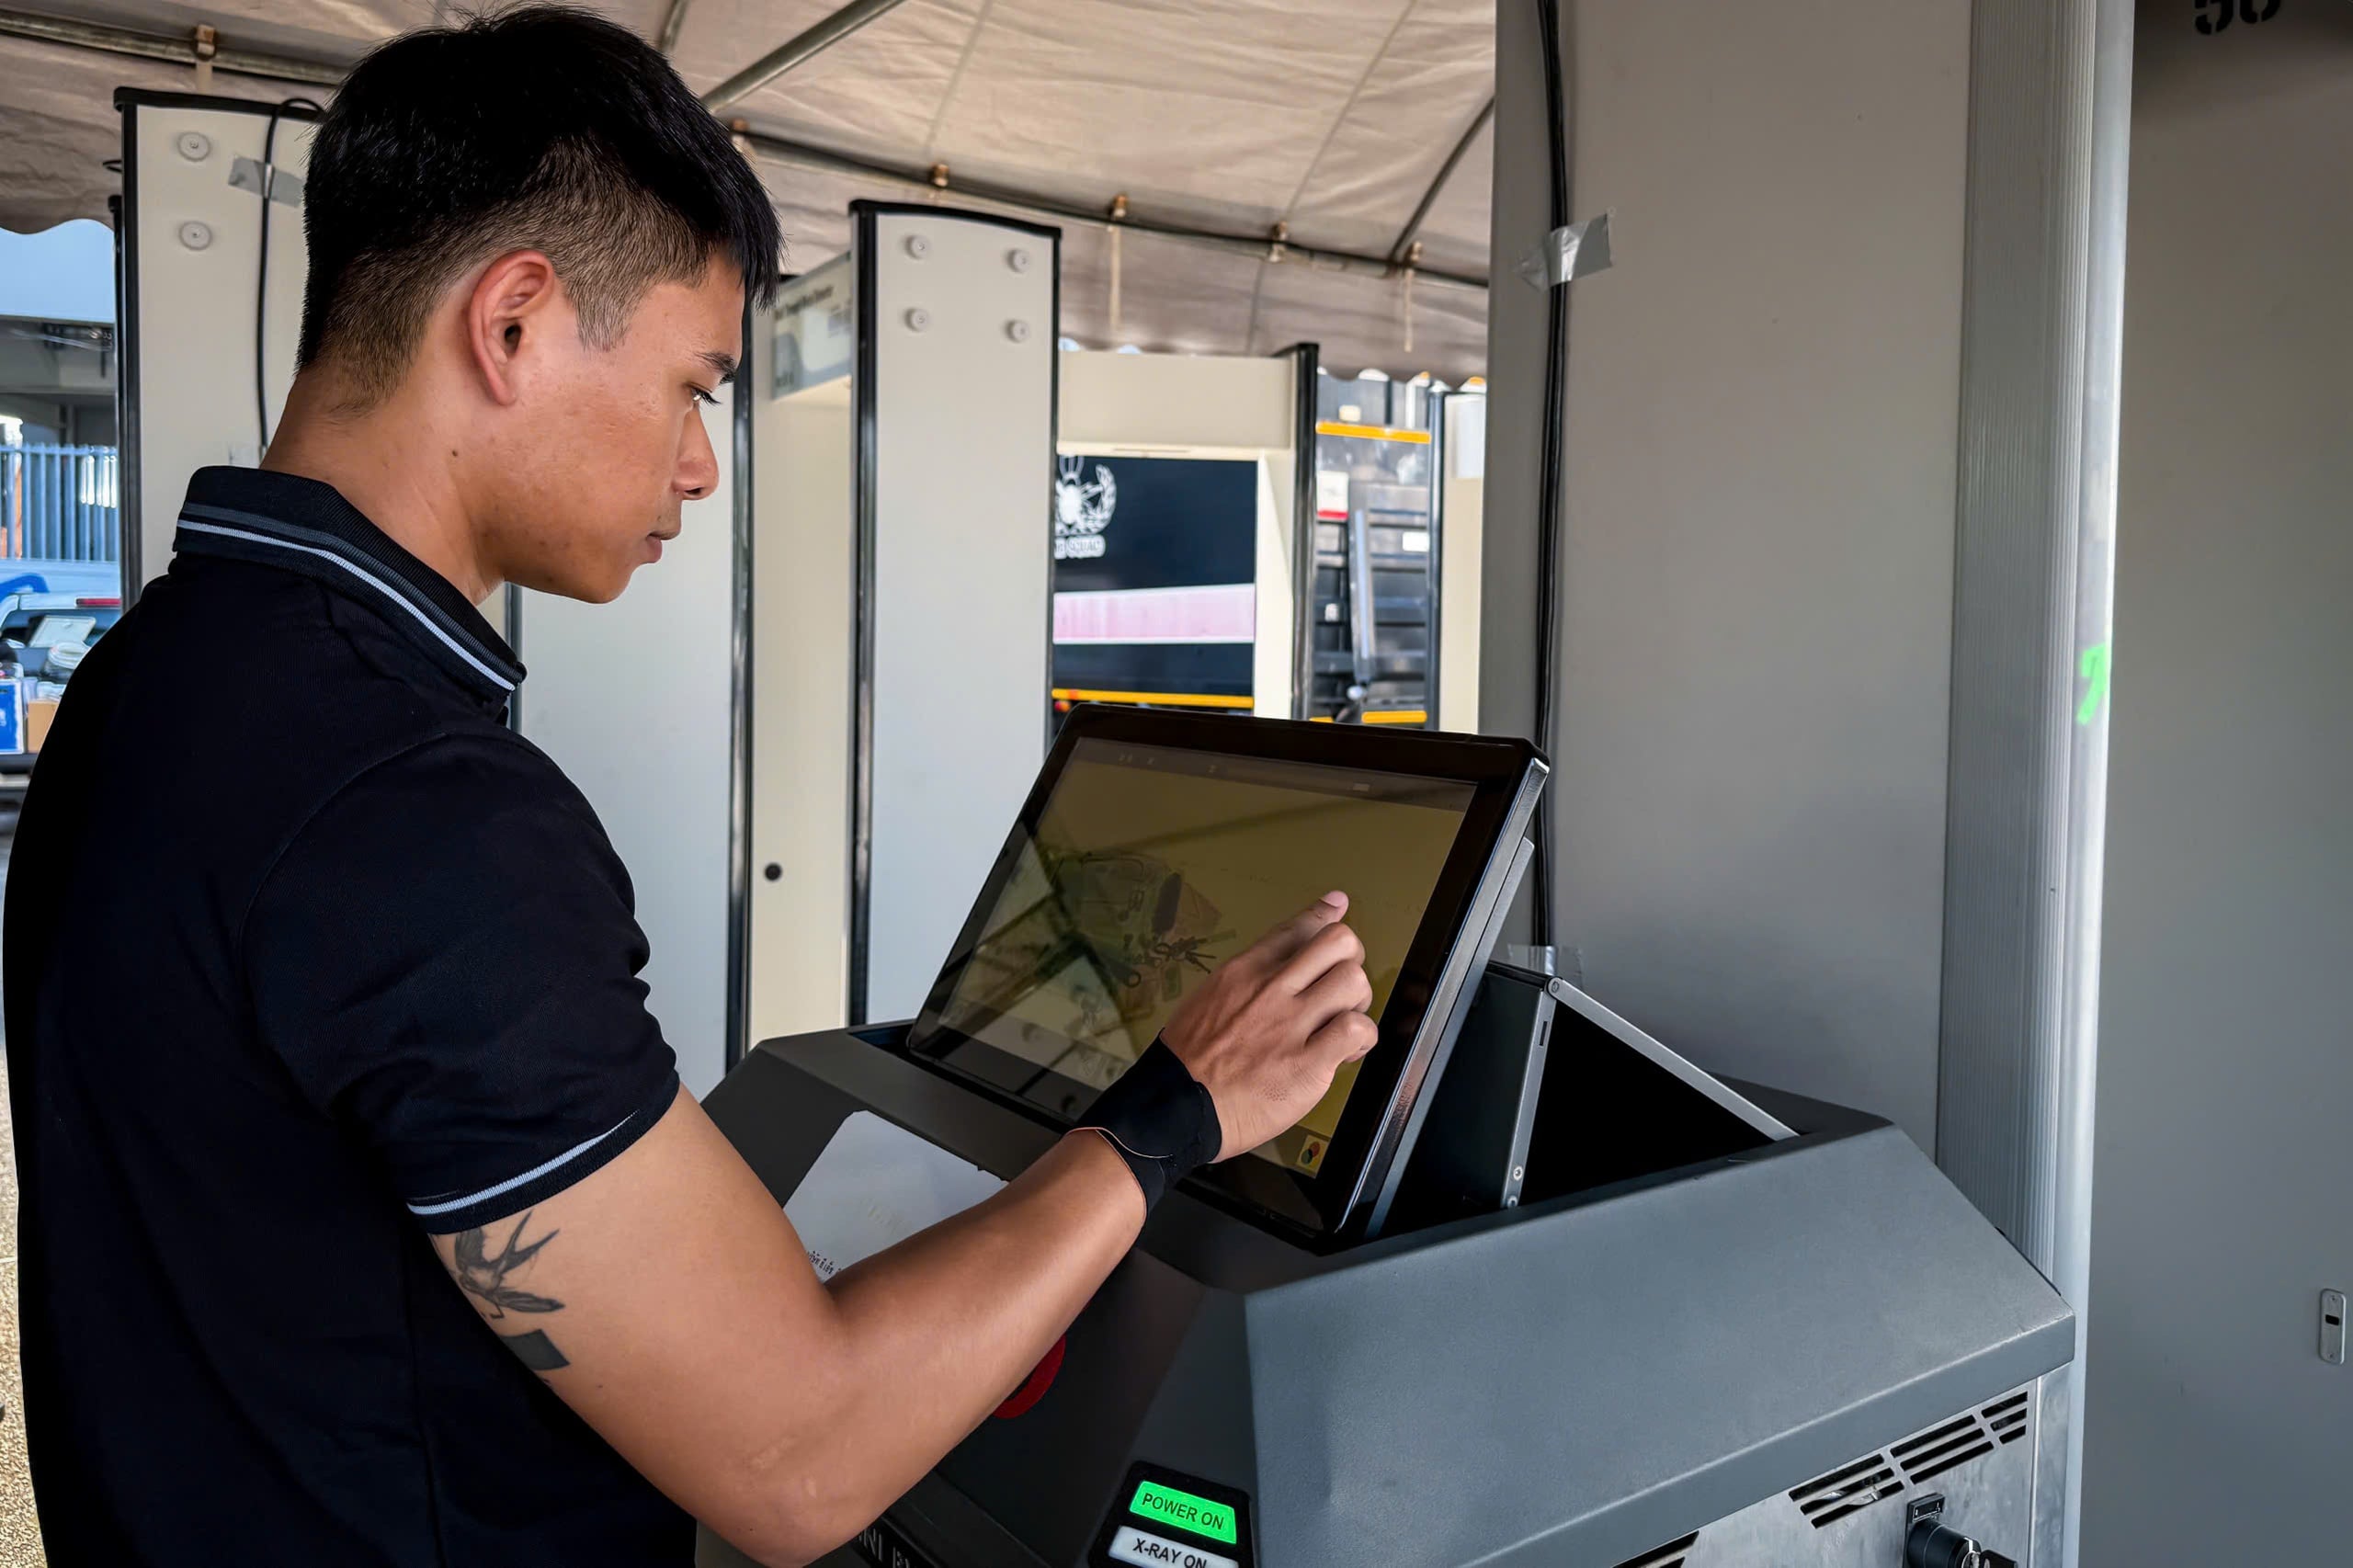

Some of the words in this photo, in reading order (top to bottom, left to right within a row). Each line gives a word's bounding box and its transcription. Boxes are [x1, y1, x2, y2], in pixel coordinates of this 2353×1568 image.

[1142, 1492, 1198, 1522] POWER
[1201, 1512, 1224, 1530] ON
[1132, 1538, 1182, 1563] X-RAY
[1184, 1554, 1208, 1568] ON
